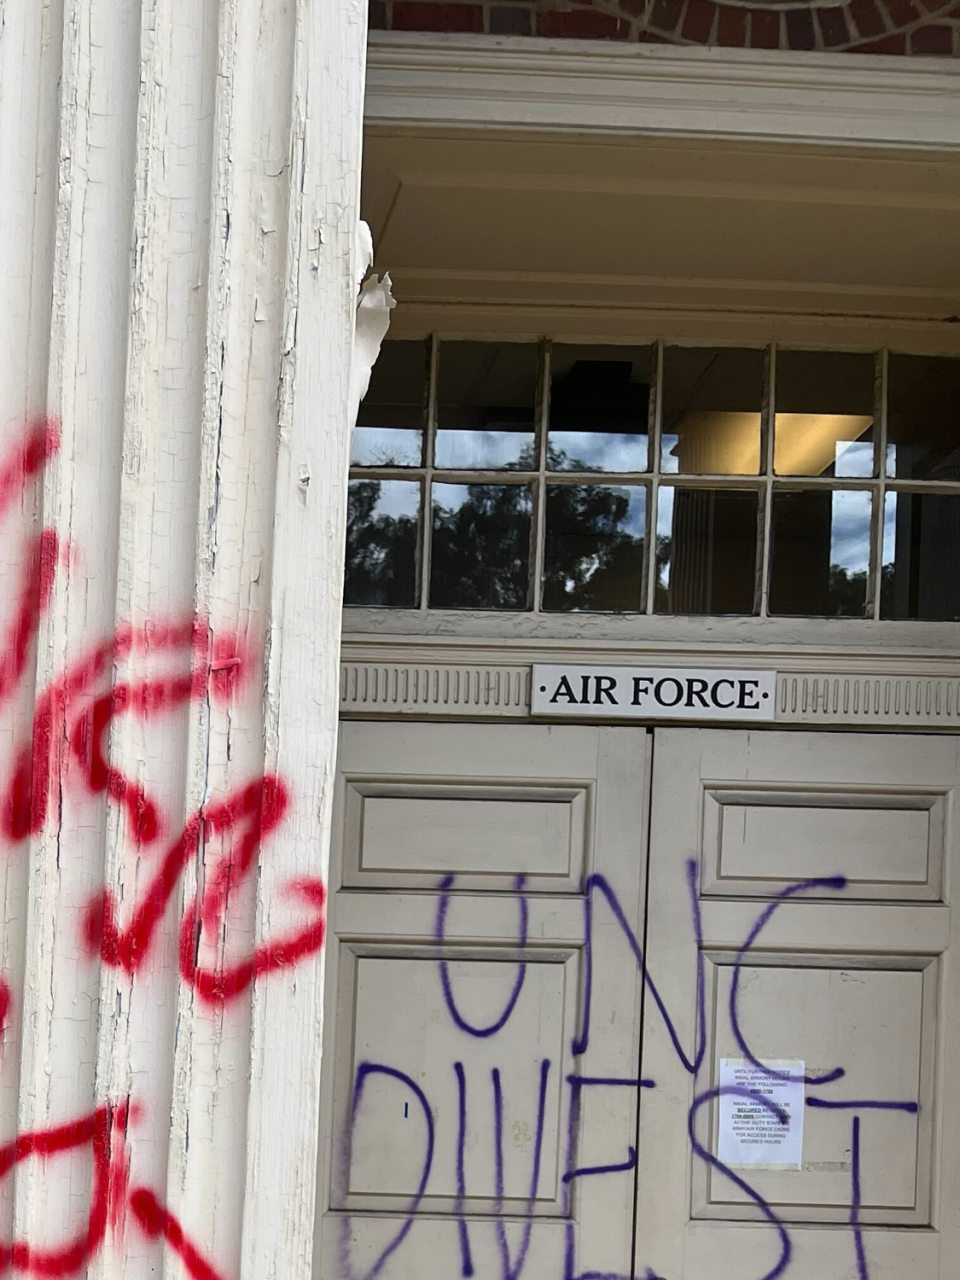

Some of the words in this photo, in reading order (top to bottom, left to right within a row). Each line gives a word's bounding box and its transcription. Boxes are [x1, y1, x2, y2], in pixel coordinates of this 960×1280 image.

[549, 674, 619, 705] AIR
[630, 676, 760, 710] FORCE
[436, 859, 848, 1086] UNC
